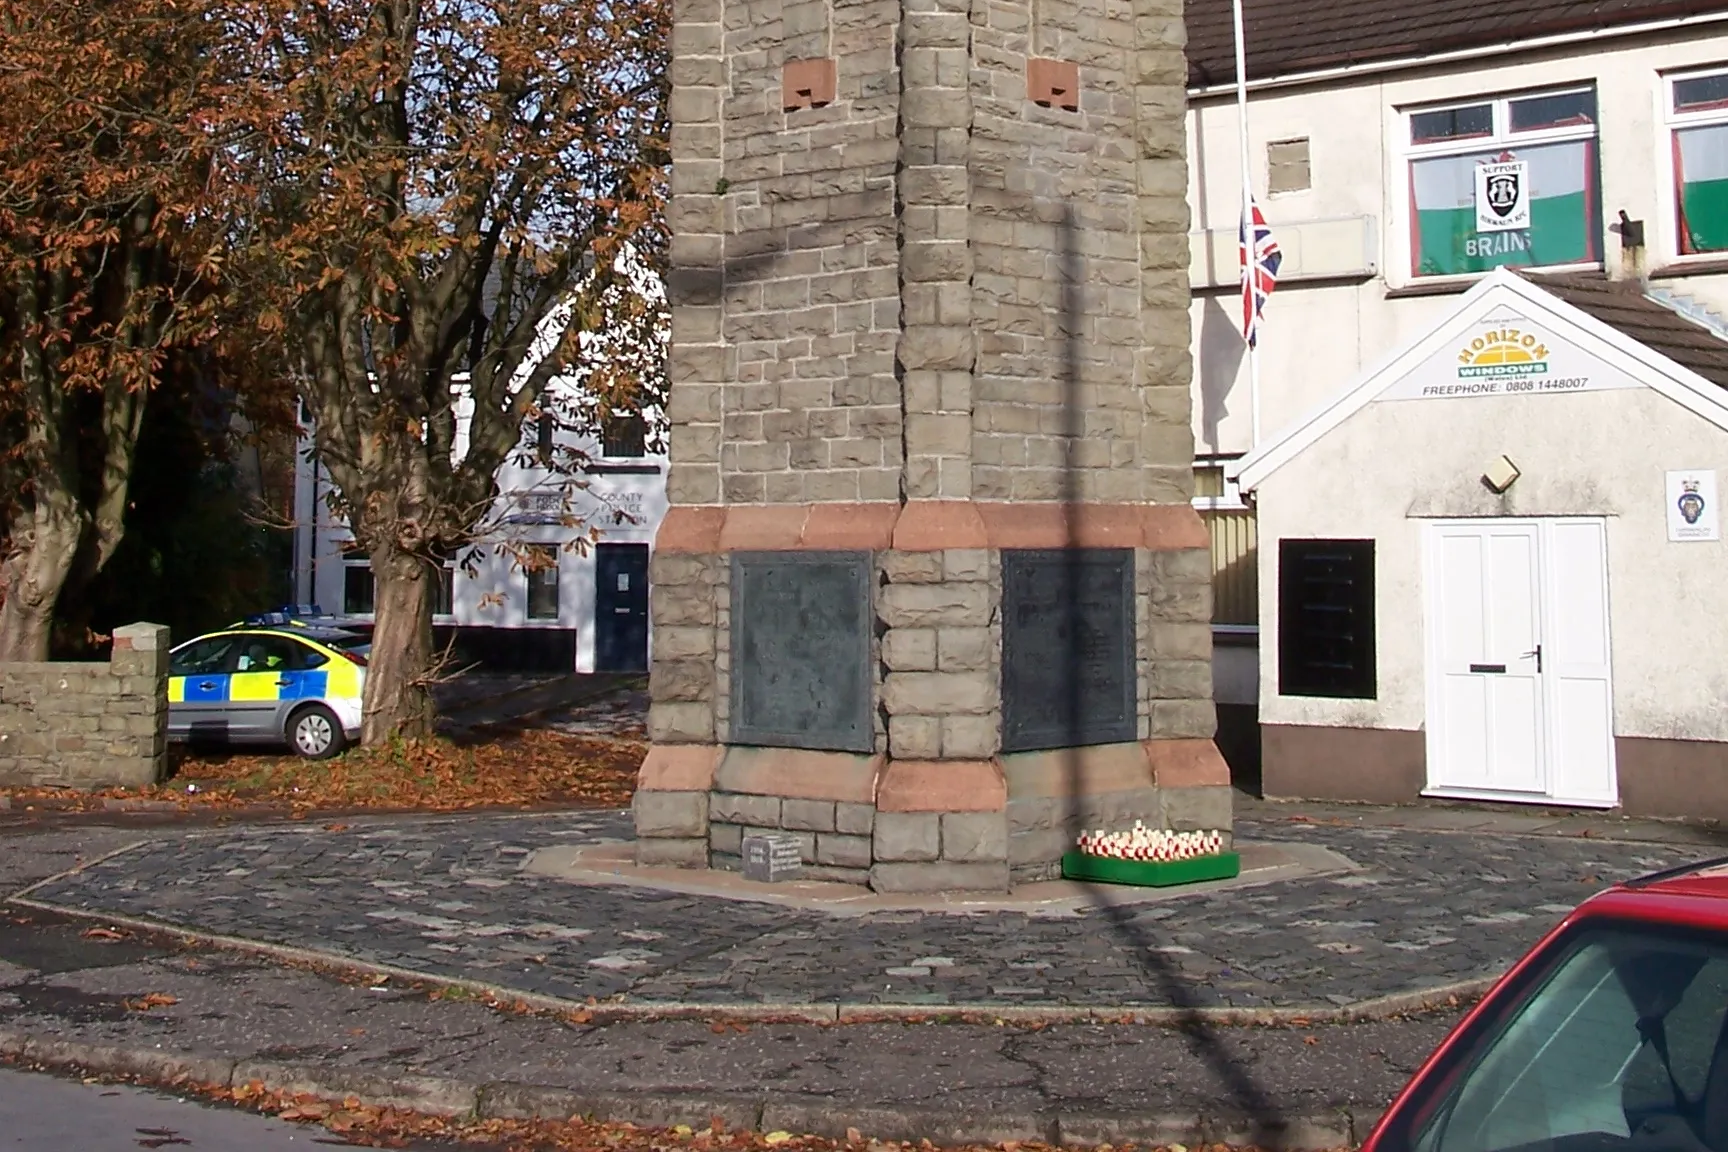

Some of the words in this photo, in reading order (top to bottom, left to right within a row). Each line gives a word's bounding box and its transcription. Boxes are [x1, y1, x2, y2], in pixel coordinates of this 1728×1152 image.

[1482, 163, 1523, 174] SUPPORT
[1466, 231, 1531, 257] BRAINS
[1458, 329, 1550, 364] HORIZON
[1460, 364, 1545, 377] WINDOWS
[1505, 380, 1534, 392] 0808
[1537, 377, 1589, 390] 1448007
[600, 492, 643, 502] COUNTY
